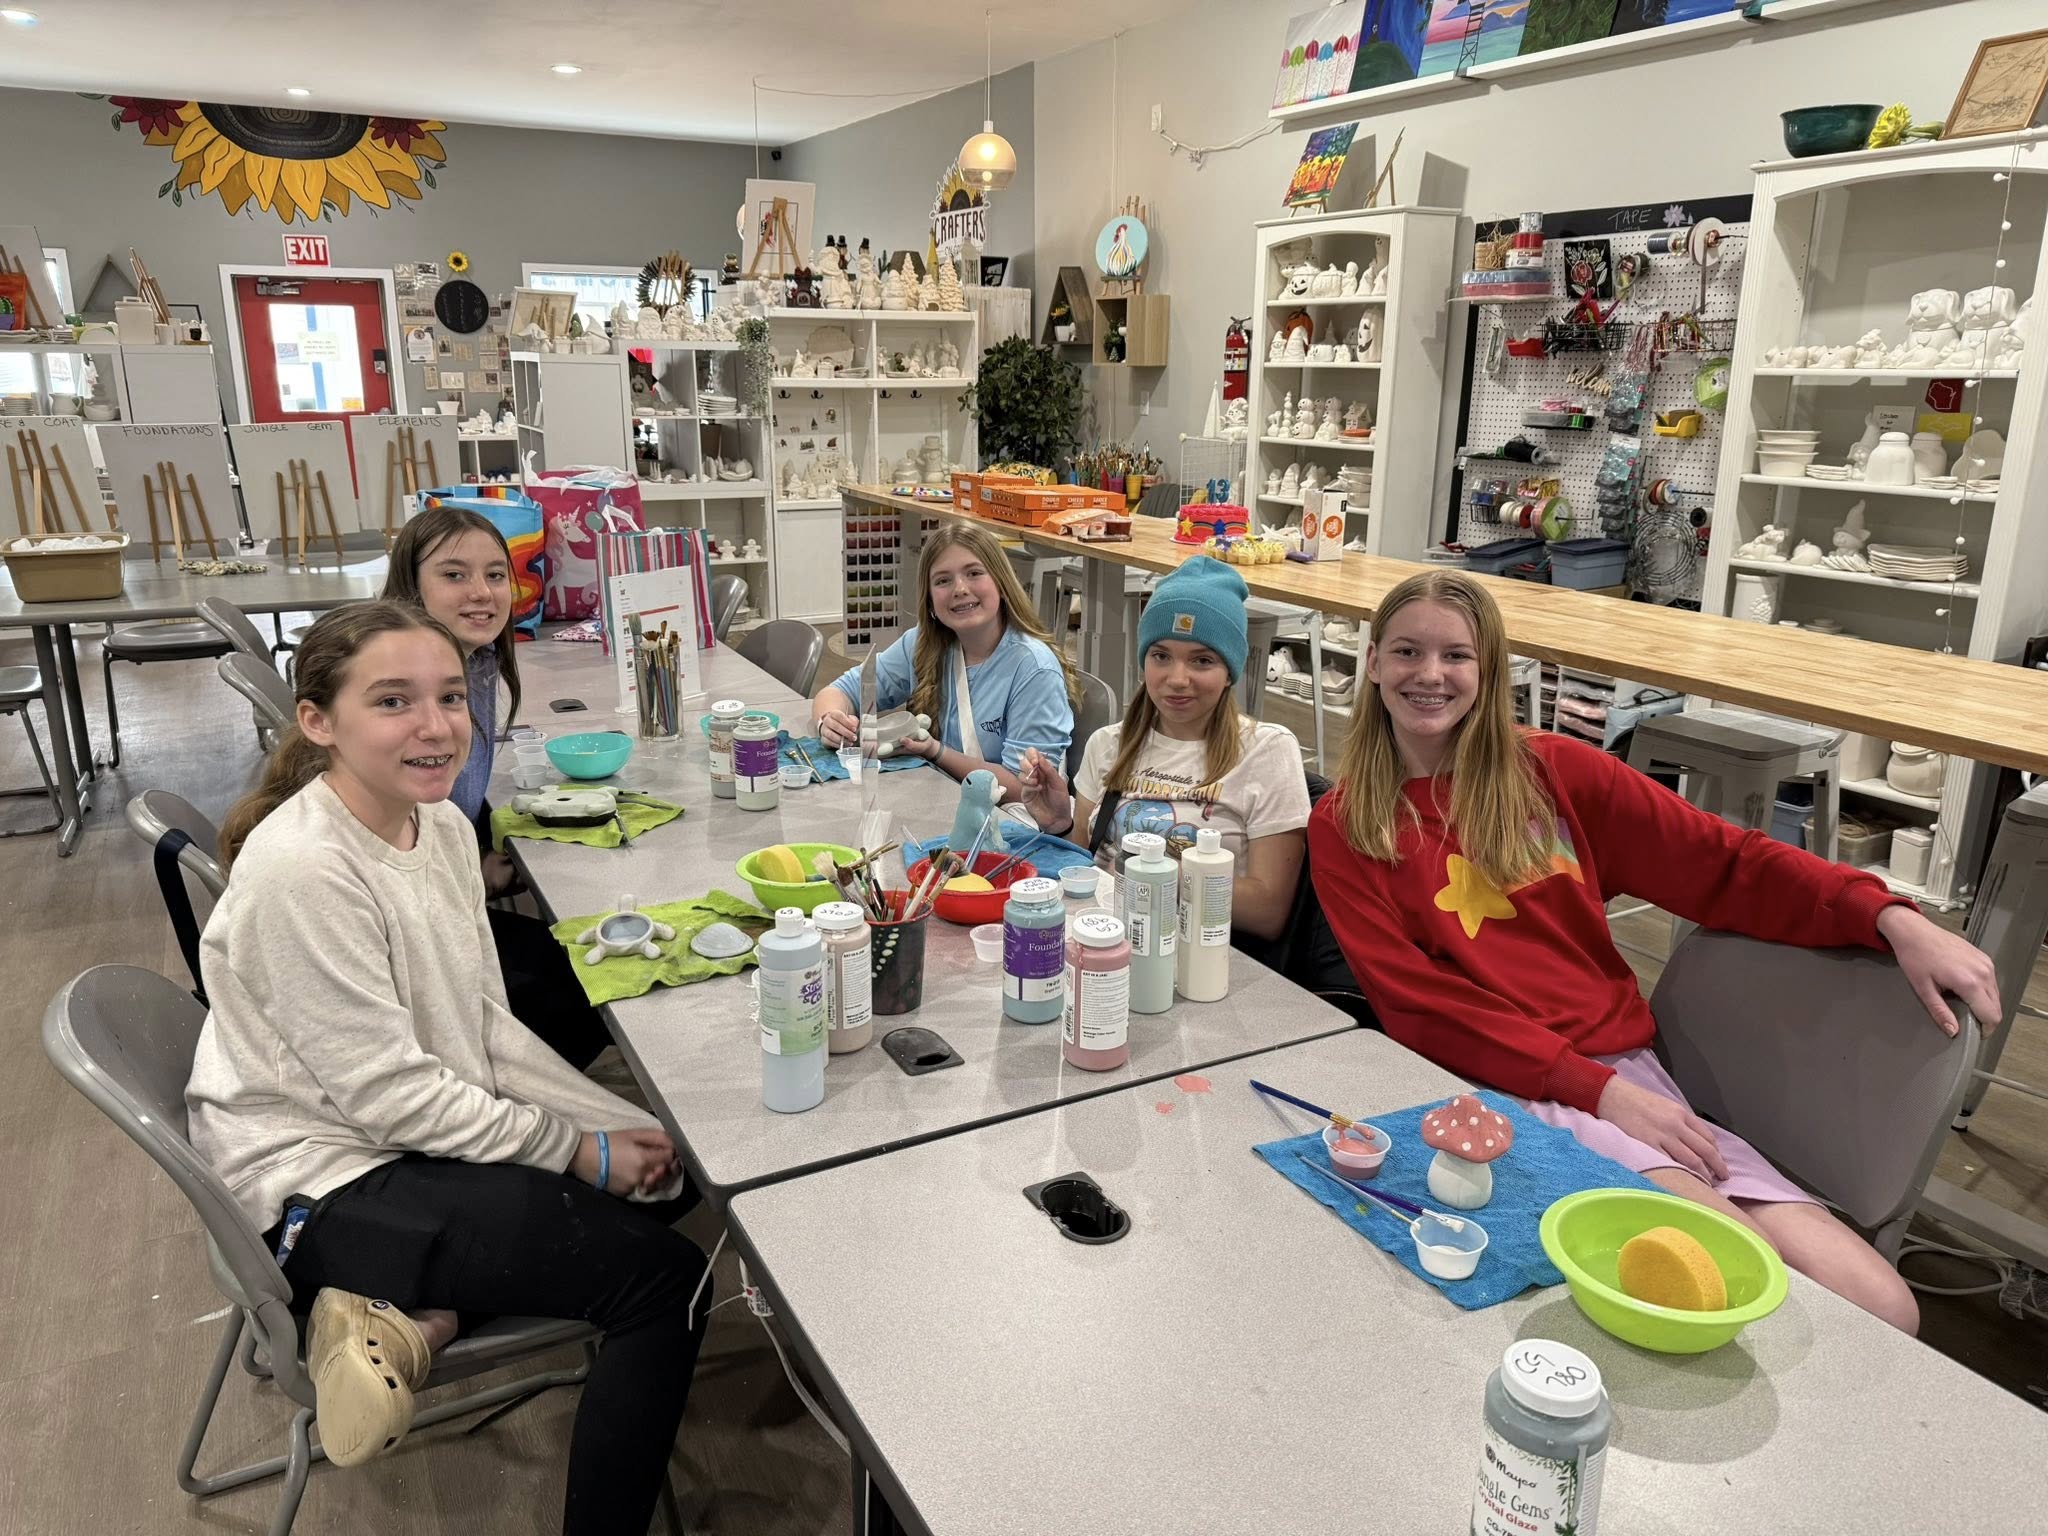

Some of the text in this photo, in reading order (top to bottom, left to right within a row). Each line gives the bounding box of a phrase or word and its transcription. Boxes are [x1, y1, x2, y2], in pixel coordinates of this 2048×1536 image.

[934, 209, 986, 248] CRAFTERS
[1608, 209, 1652, 231] TAPE
[285, 238, 325, 261] EXIT
[1566, 363, 1610, 397] welcom
[44, 417, 77, 427] COAT
[122, 424, 214, 438] FOUNDATIONS
[243, 423, 333, 434] JUNGLE GEM
[379, 416, 442, 427] ELEMENTS
[1206, 479, 1230, 503] 13
[1546, 1366, 1586, 1386] 780
[1479, 1486, 1504, 1517] Crystal
[1506, 1513, 1538, 1532] Glaze
[1511, 1495, 1550, 1520] Gems
